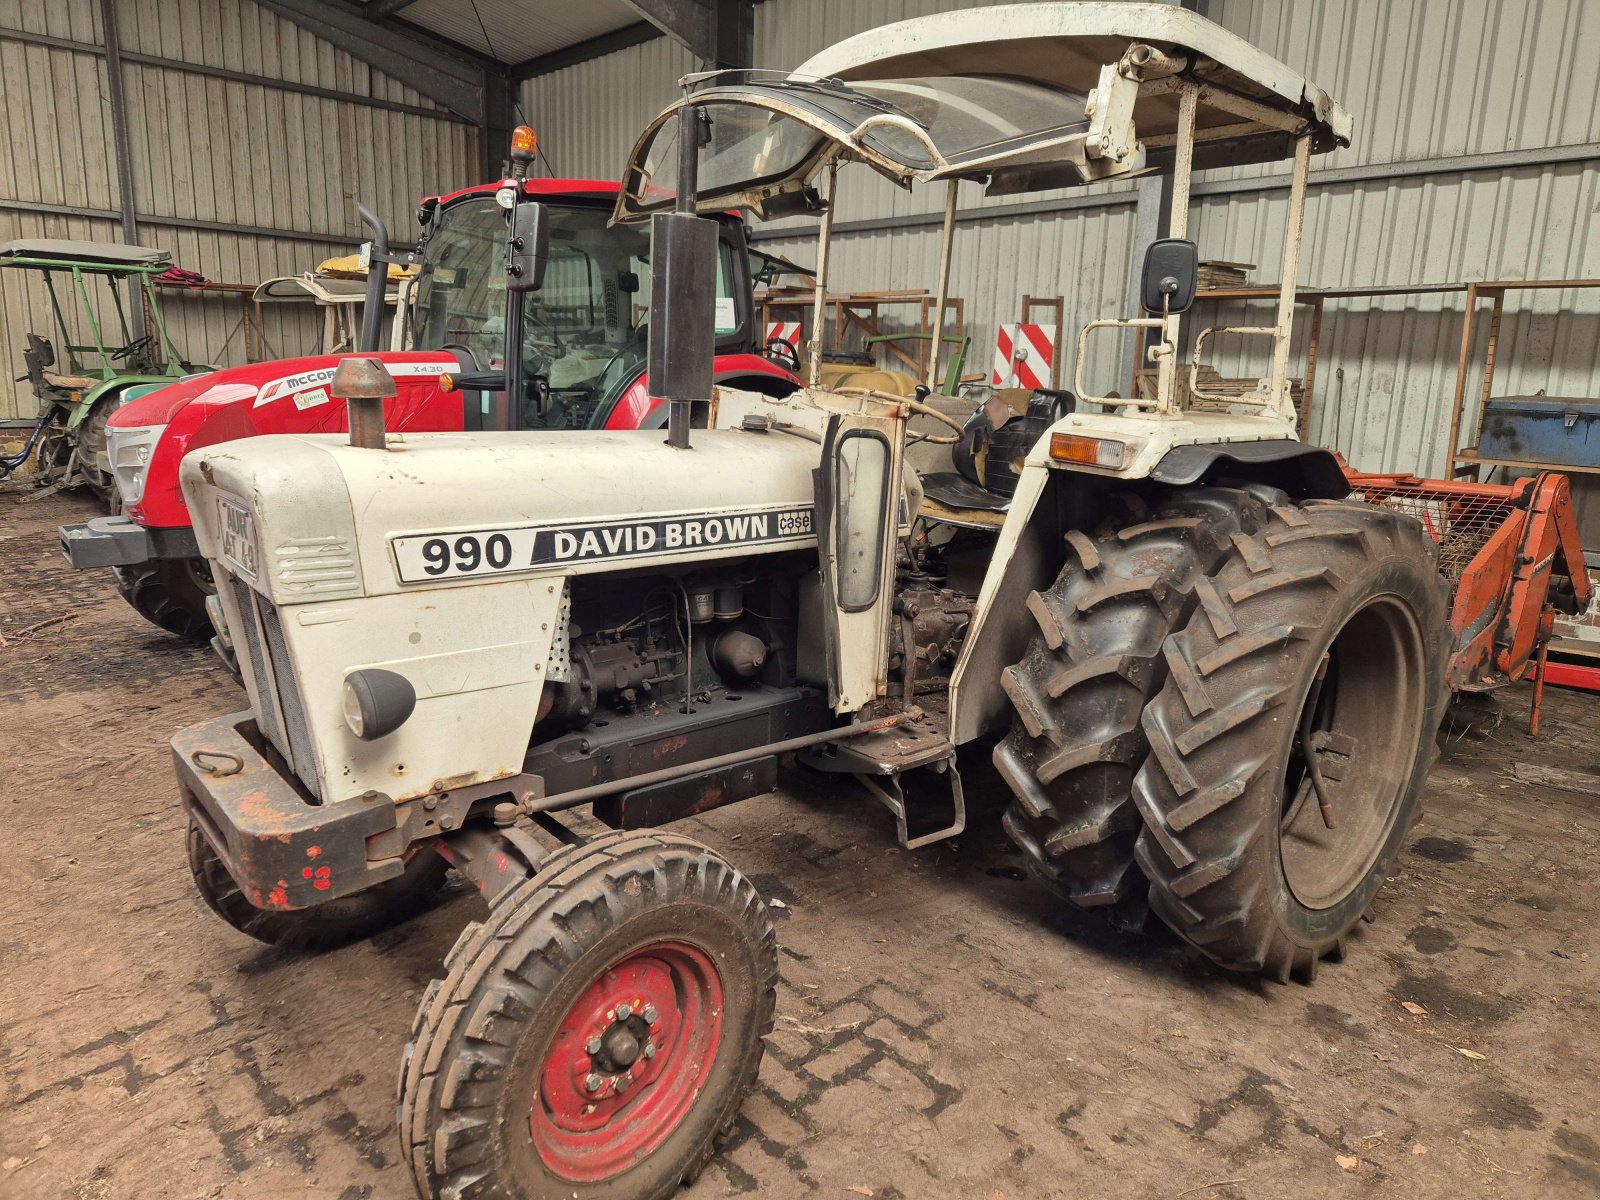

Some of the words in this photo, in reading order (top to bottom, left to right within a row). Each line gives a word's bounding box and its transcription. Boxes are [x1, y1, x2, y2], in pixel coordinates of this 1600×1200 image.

[422, 533, 512, 576] 990
[554, 526, 656, 559] DAVID
[665, 514, 768, 548] BROWN
